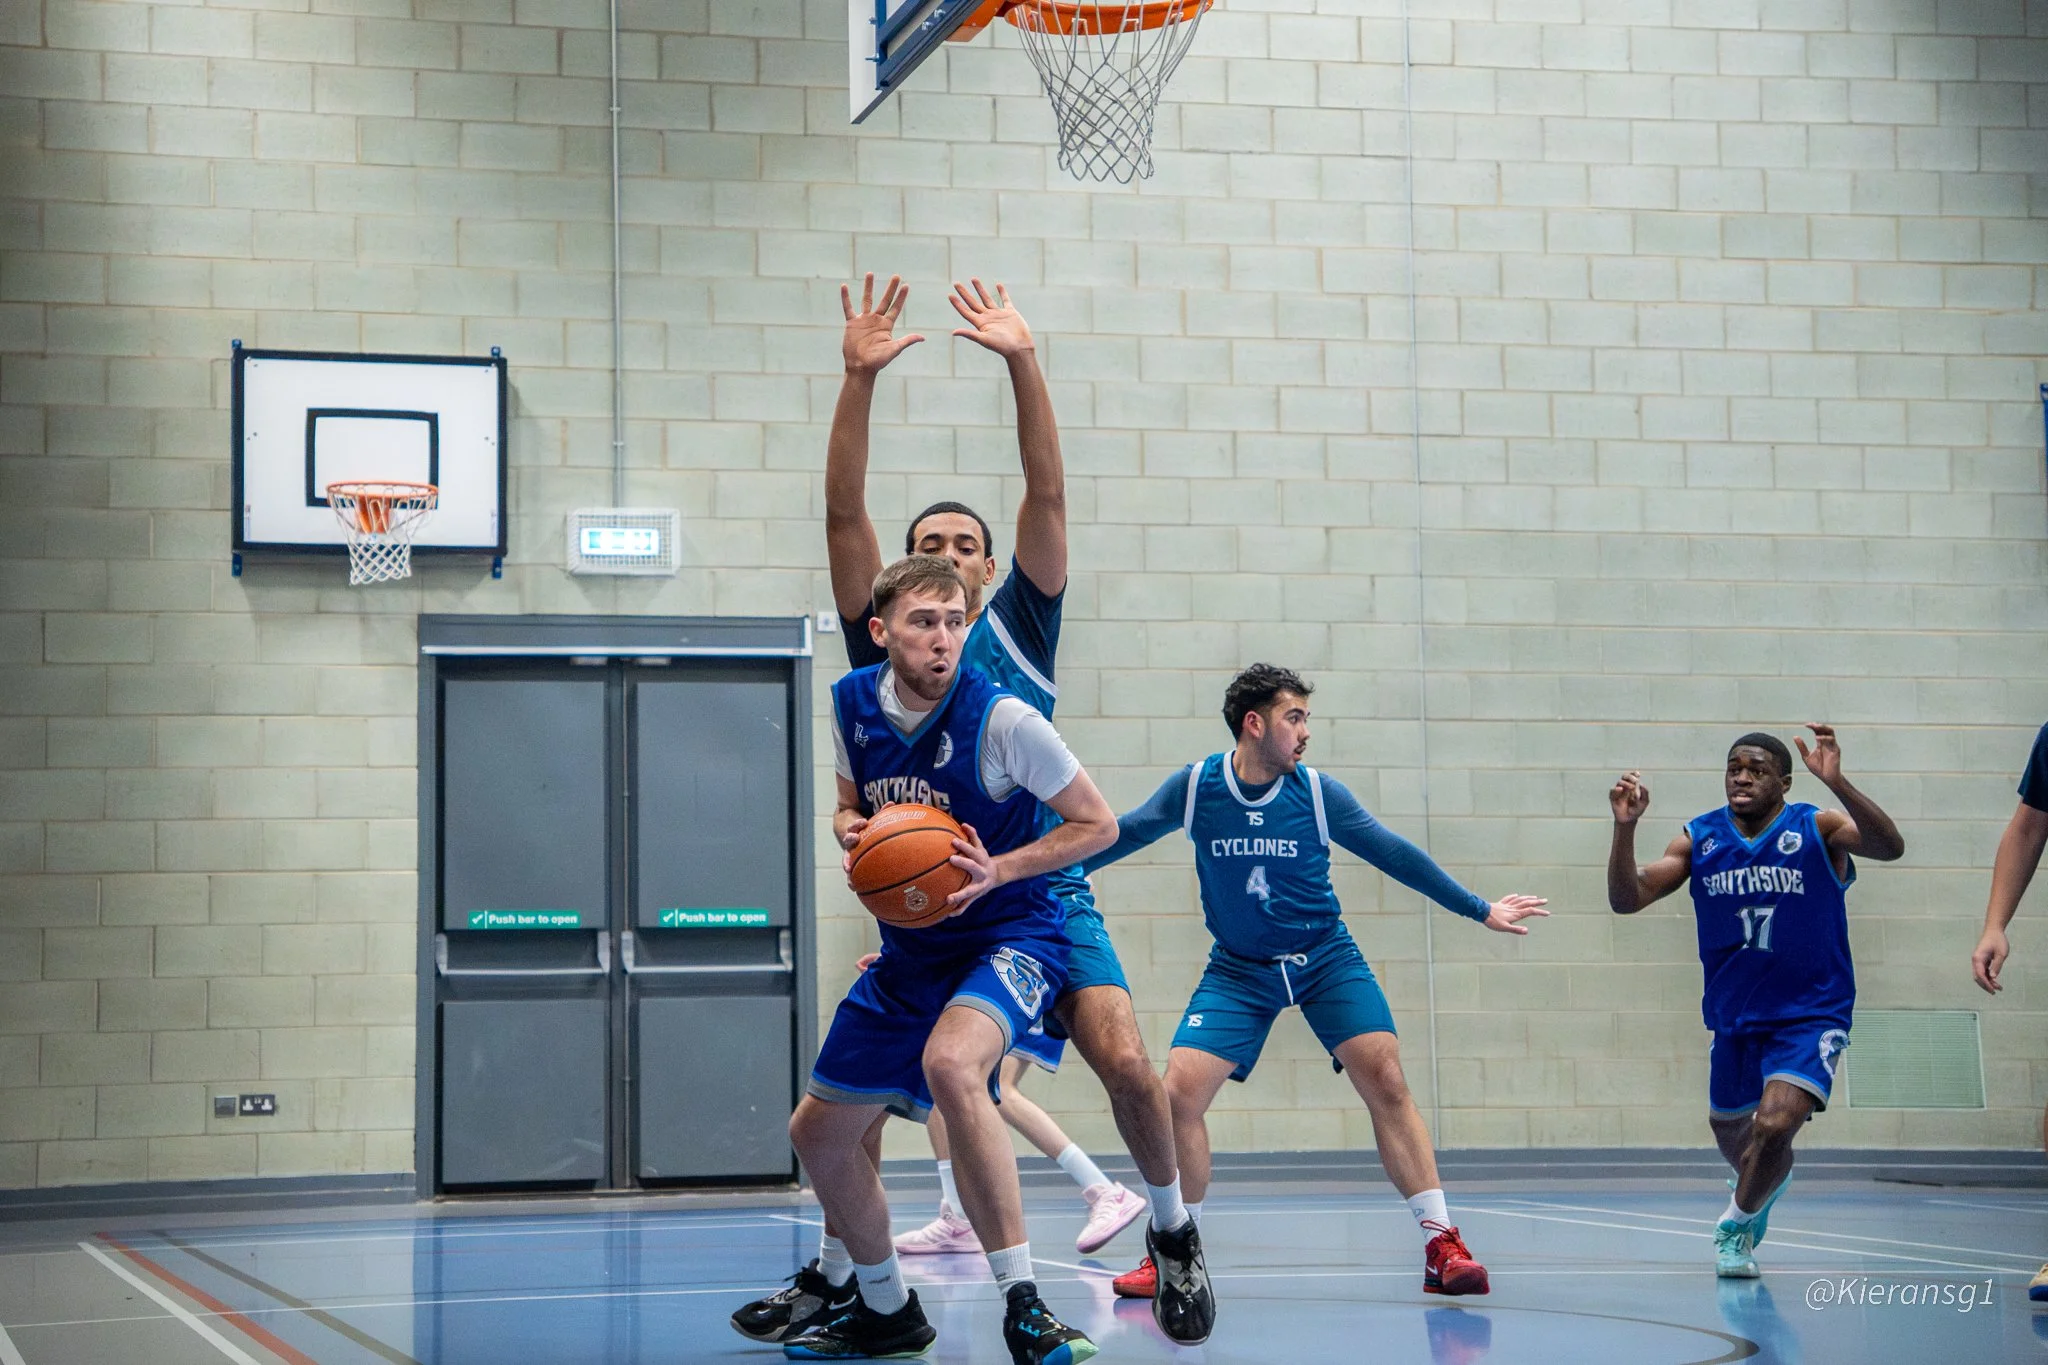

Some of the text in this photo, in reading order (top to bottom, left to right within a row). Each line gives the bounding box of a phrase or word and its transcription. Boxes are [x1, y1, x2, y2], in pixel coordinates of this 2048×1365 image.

[1245, 811, 1264, 826] TS
[1211, 838, 1298, 857] CYCLONES
[1246, 865, 1271, 901] 4
[1702, 865, 1805, 896] SOUTHSIDE
[489, 914, 578, 926] Push bar to open
[679, 912, 766, 924] Push bar to open
[1736, 904, 1777, 952] 17
